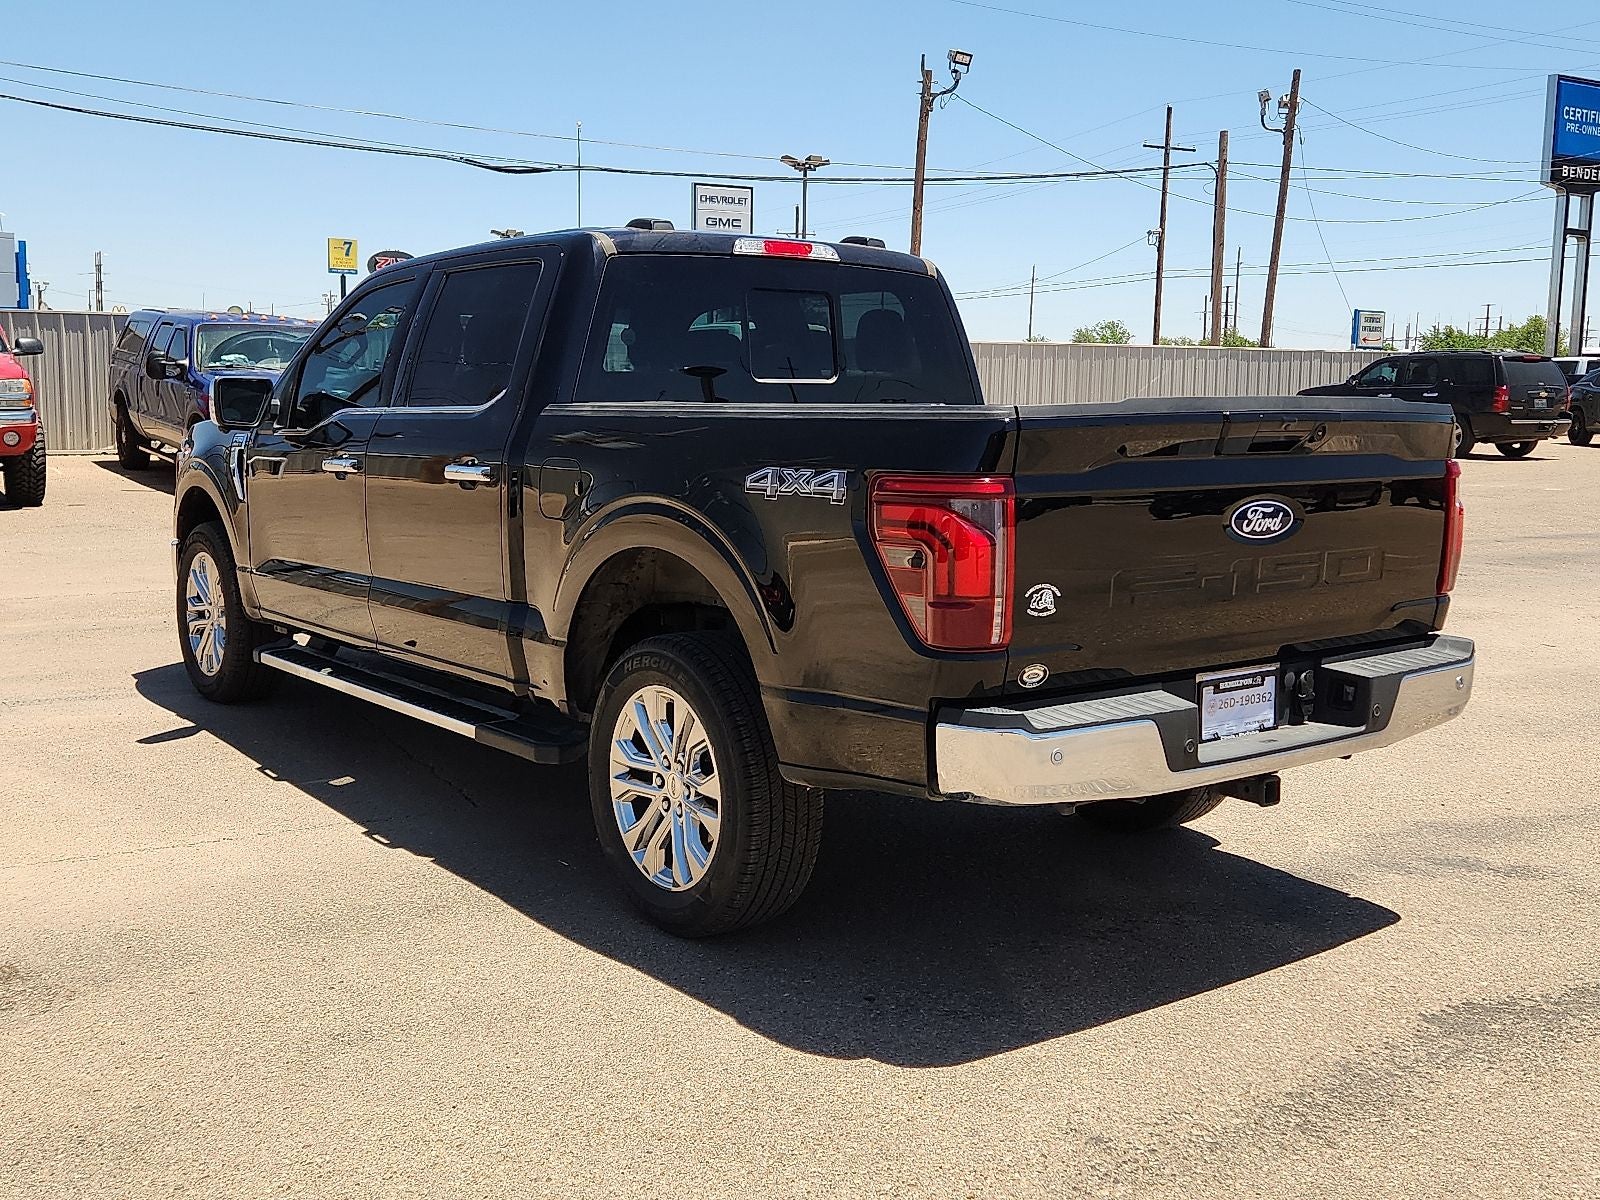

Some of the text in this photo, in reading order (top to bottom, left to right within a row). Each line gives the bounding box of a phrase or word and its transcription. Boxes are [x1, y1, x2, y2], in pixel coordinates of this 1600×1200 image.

[1563, 106, 1600, 124] CERTIFI
[700, 194, 748, 207] CHEVROLET
[706, 217, 741, 228] GMC
[343, 241, 352, 257] 7
[1242, 505, 1284, 533] Ford
[1110, 547, 1384, 607] F-150
[1218, 692, 1273, 709] 26D-190362
